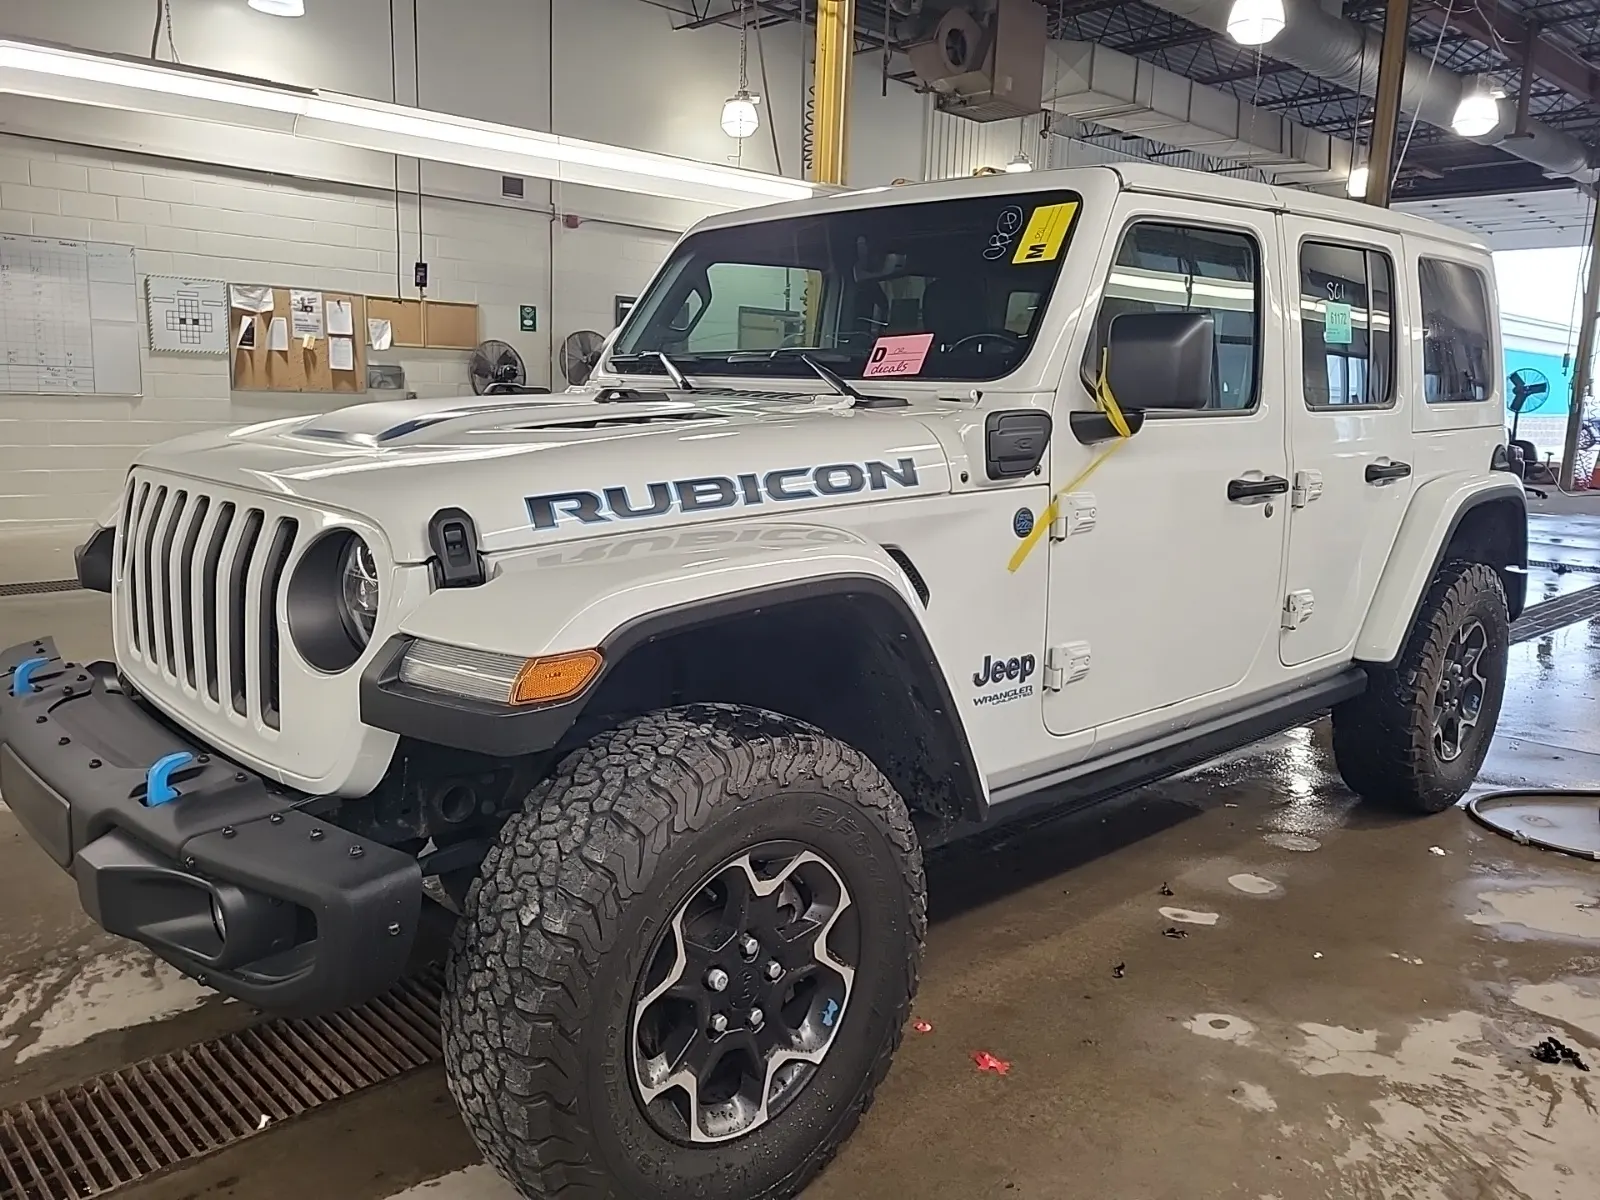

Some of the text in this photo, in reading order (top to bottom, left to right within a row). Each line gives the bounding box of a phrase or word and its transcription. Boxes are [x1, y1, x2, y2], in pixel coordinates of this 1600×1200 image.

[1025, 244, 1047, 259] M
[871, 346, 888, 363] D
[870, 360, 908, 375] decals
[523, 457, 920, 531] RUBICON
[972, 653, 1036, 688] Jeep
[972, 685, 1033, 706] WRANGLER
